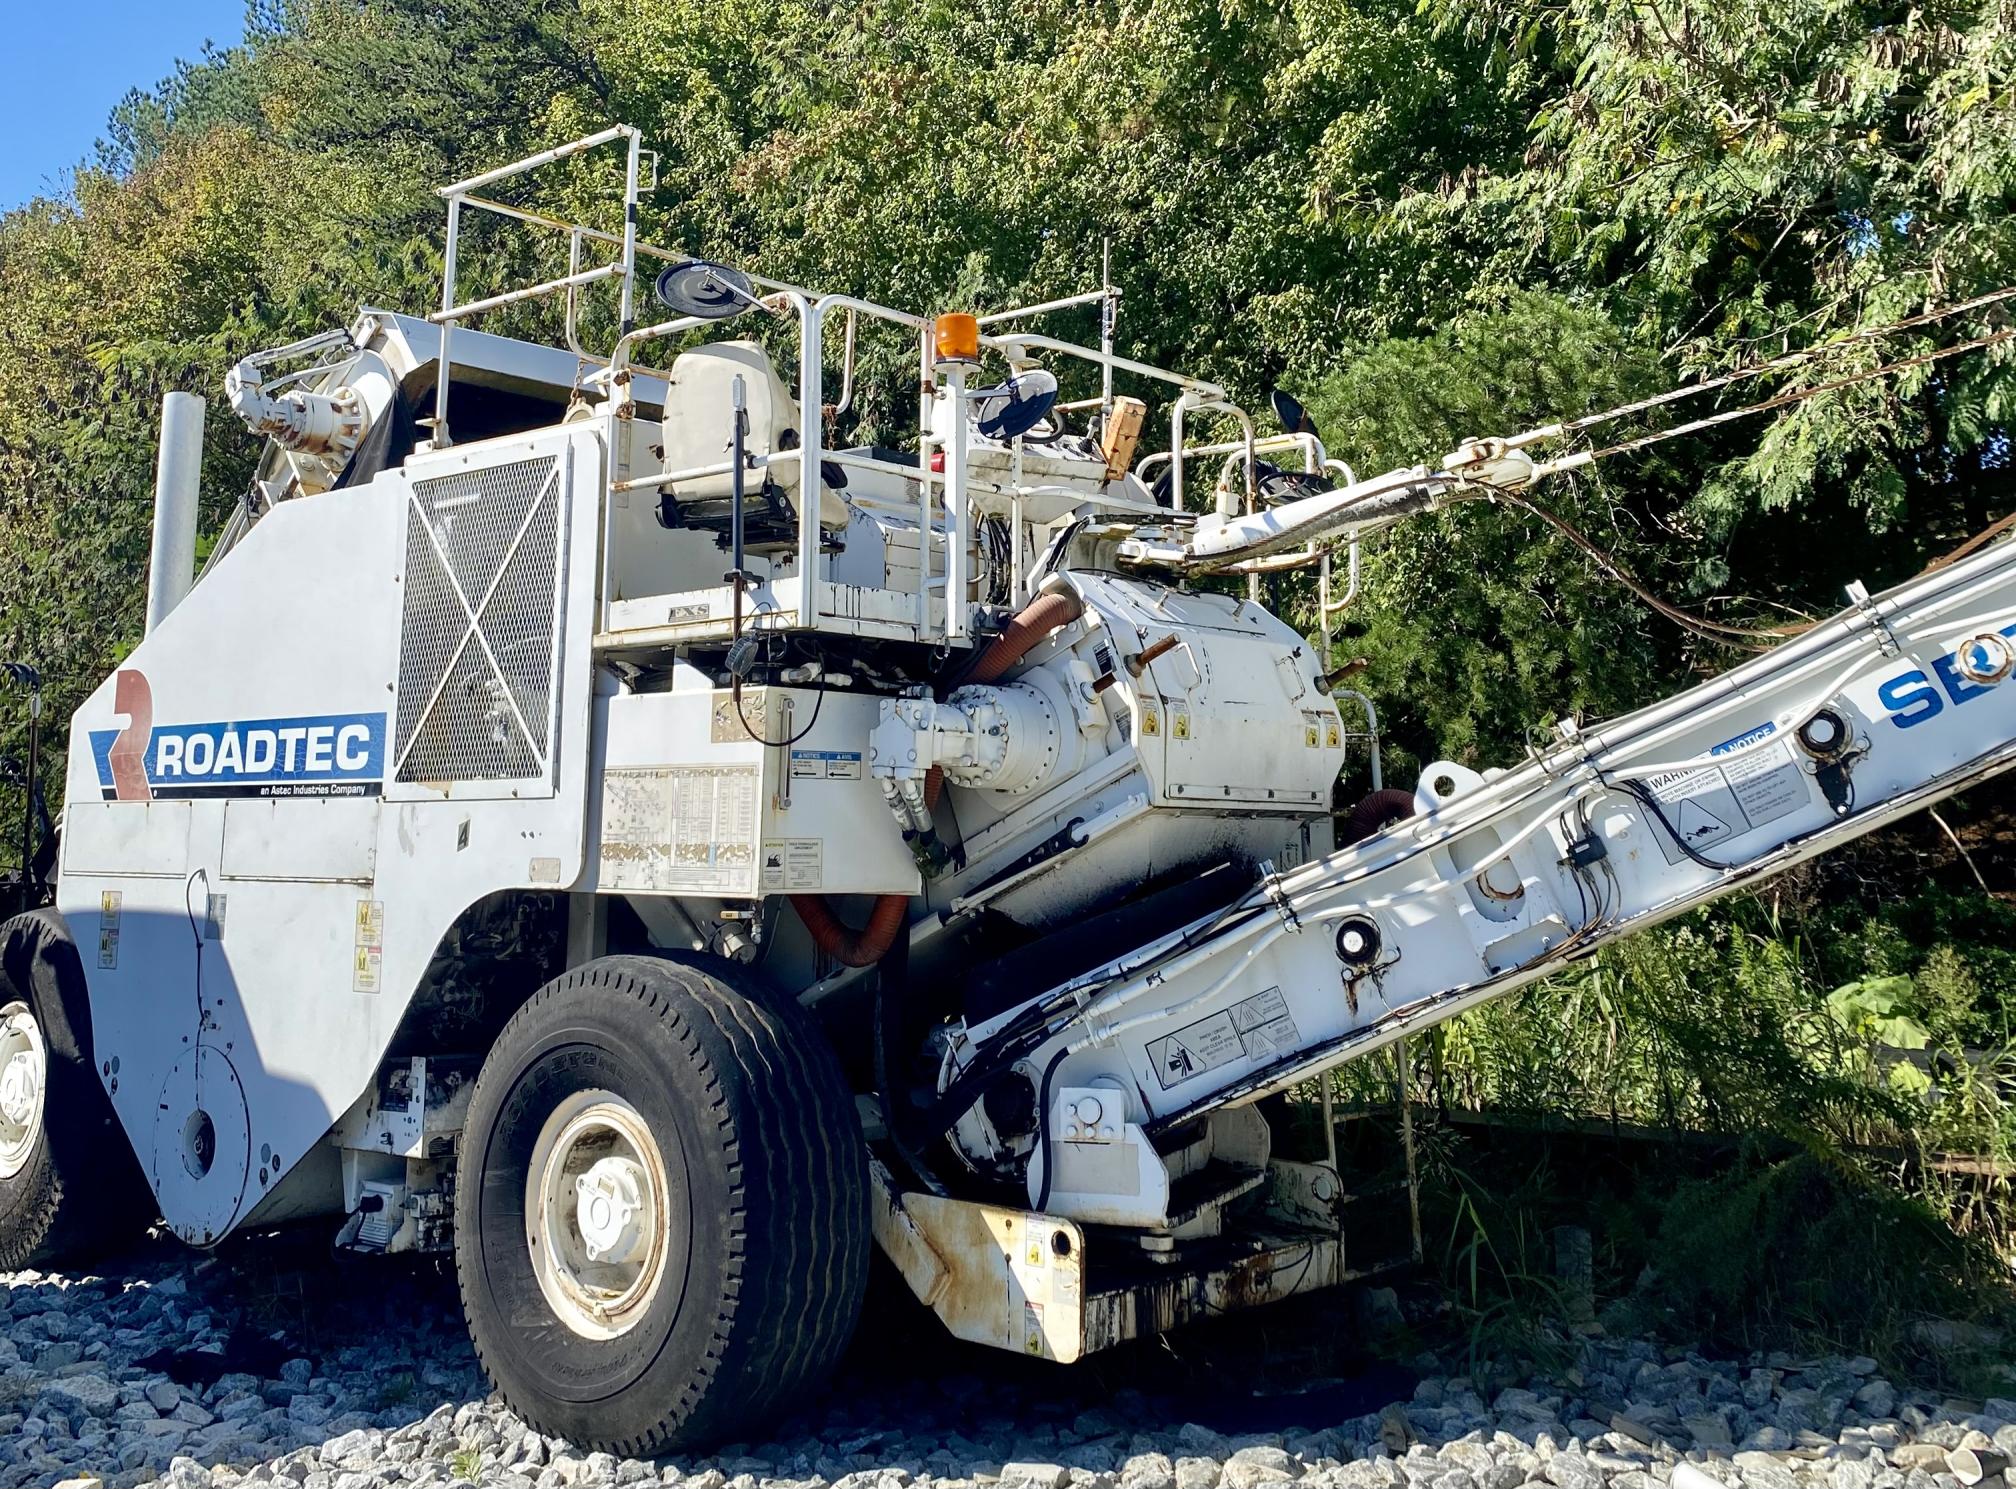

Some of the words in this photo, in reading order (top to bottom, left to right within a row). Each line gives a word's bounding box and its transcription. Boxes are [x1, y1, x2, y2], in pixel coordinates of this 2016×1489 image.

[1878, 624, 2016, 729] SE
[156, 723, 370, 777] ROADTEC
[1728, 727, 1772, 750] NOTICE
[260, 786, 270, 796] an
[270, 785, 292, 796] Astec
[293, 784, 329, 796] Industries
[330, 784, 366, 796] Company
